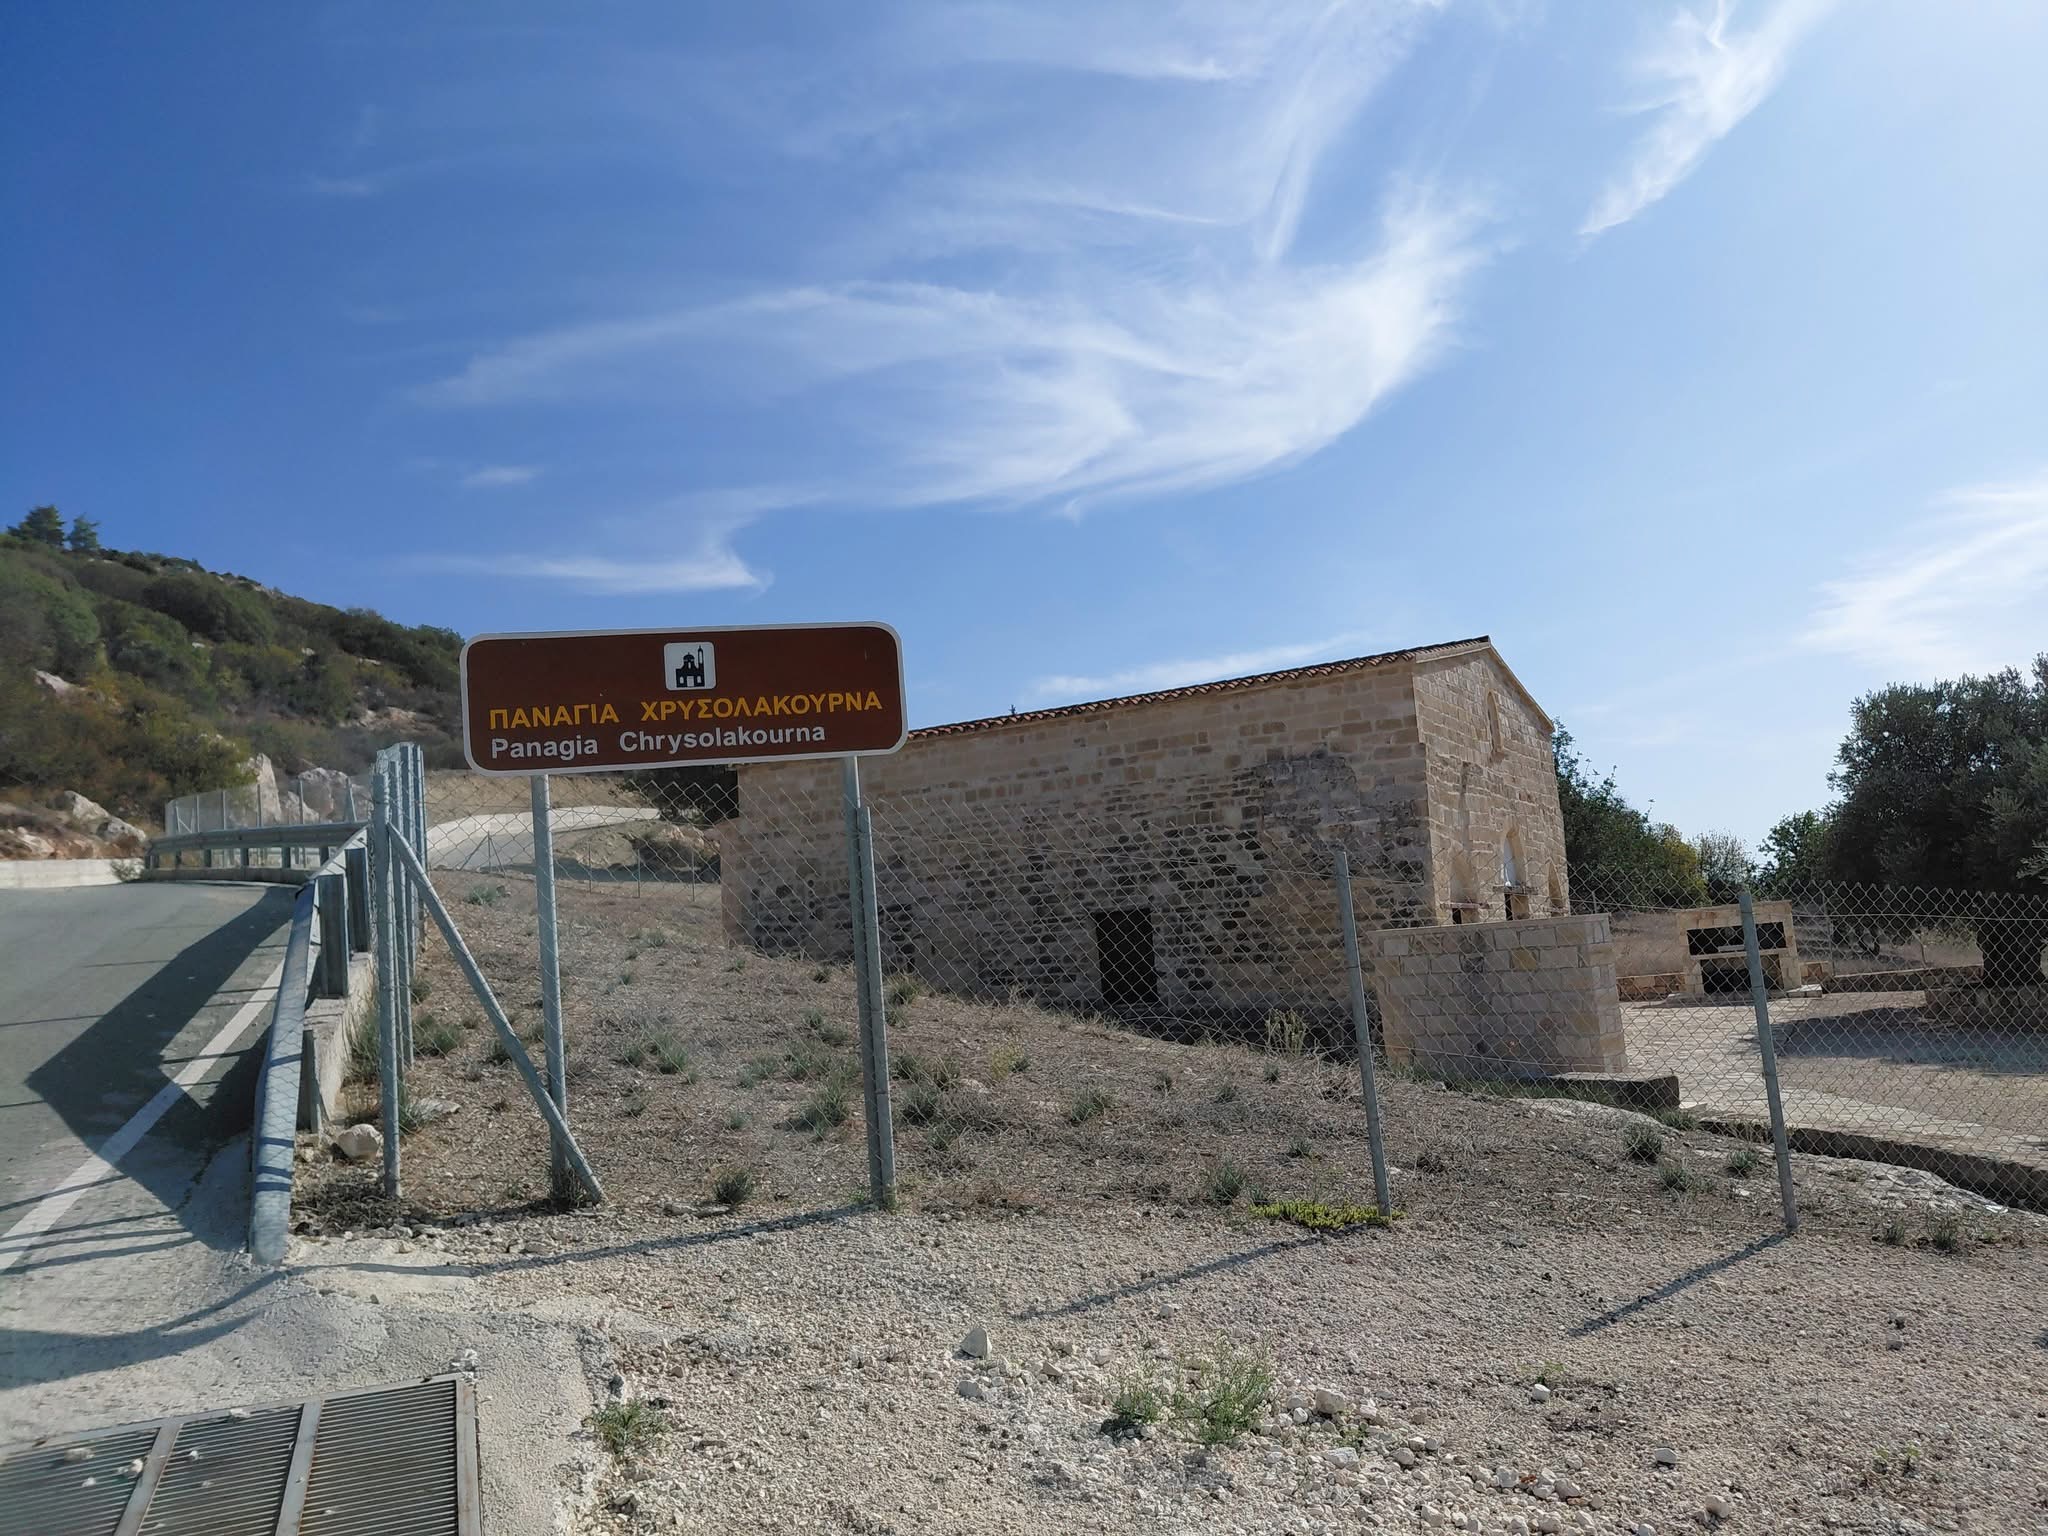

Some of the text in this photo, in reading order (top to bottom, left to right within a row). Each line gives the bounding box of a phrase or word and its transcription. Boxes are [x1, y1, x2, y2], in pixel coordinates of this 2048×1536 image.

[489, 690, 882, 730] ΠΑΝΑΓΙΑ ΧΡΥΣΟΛΑΚΟΥΡΝΑ
[491, 723, 825, 761] Panagia Chrysolakourna
